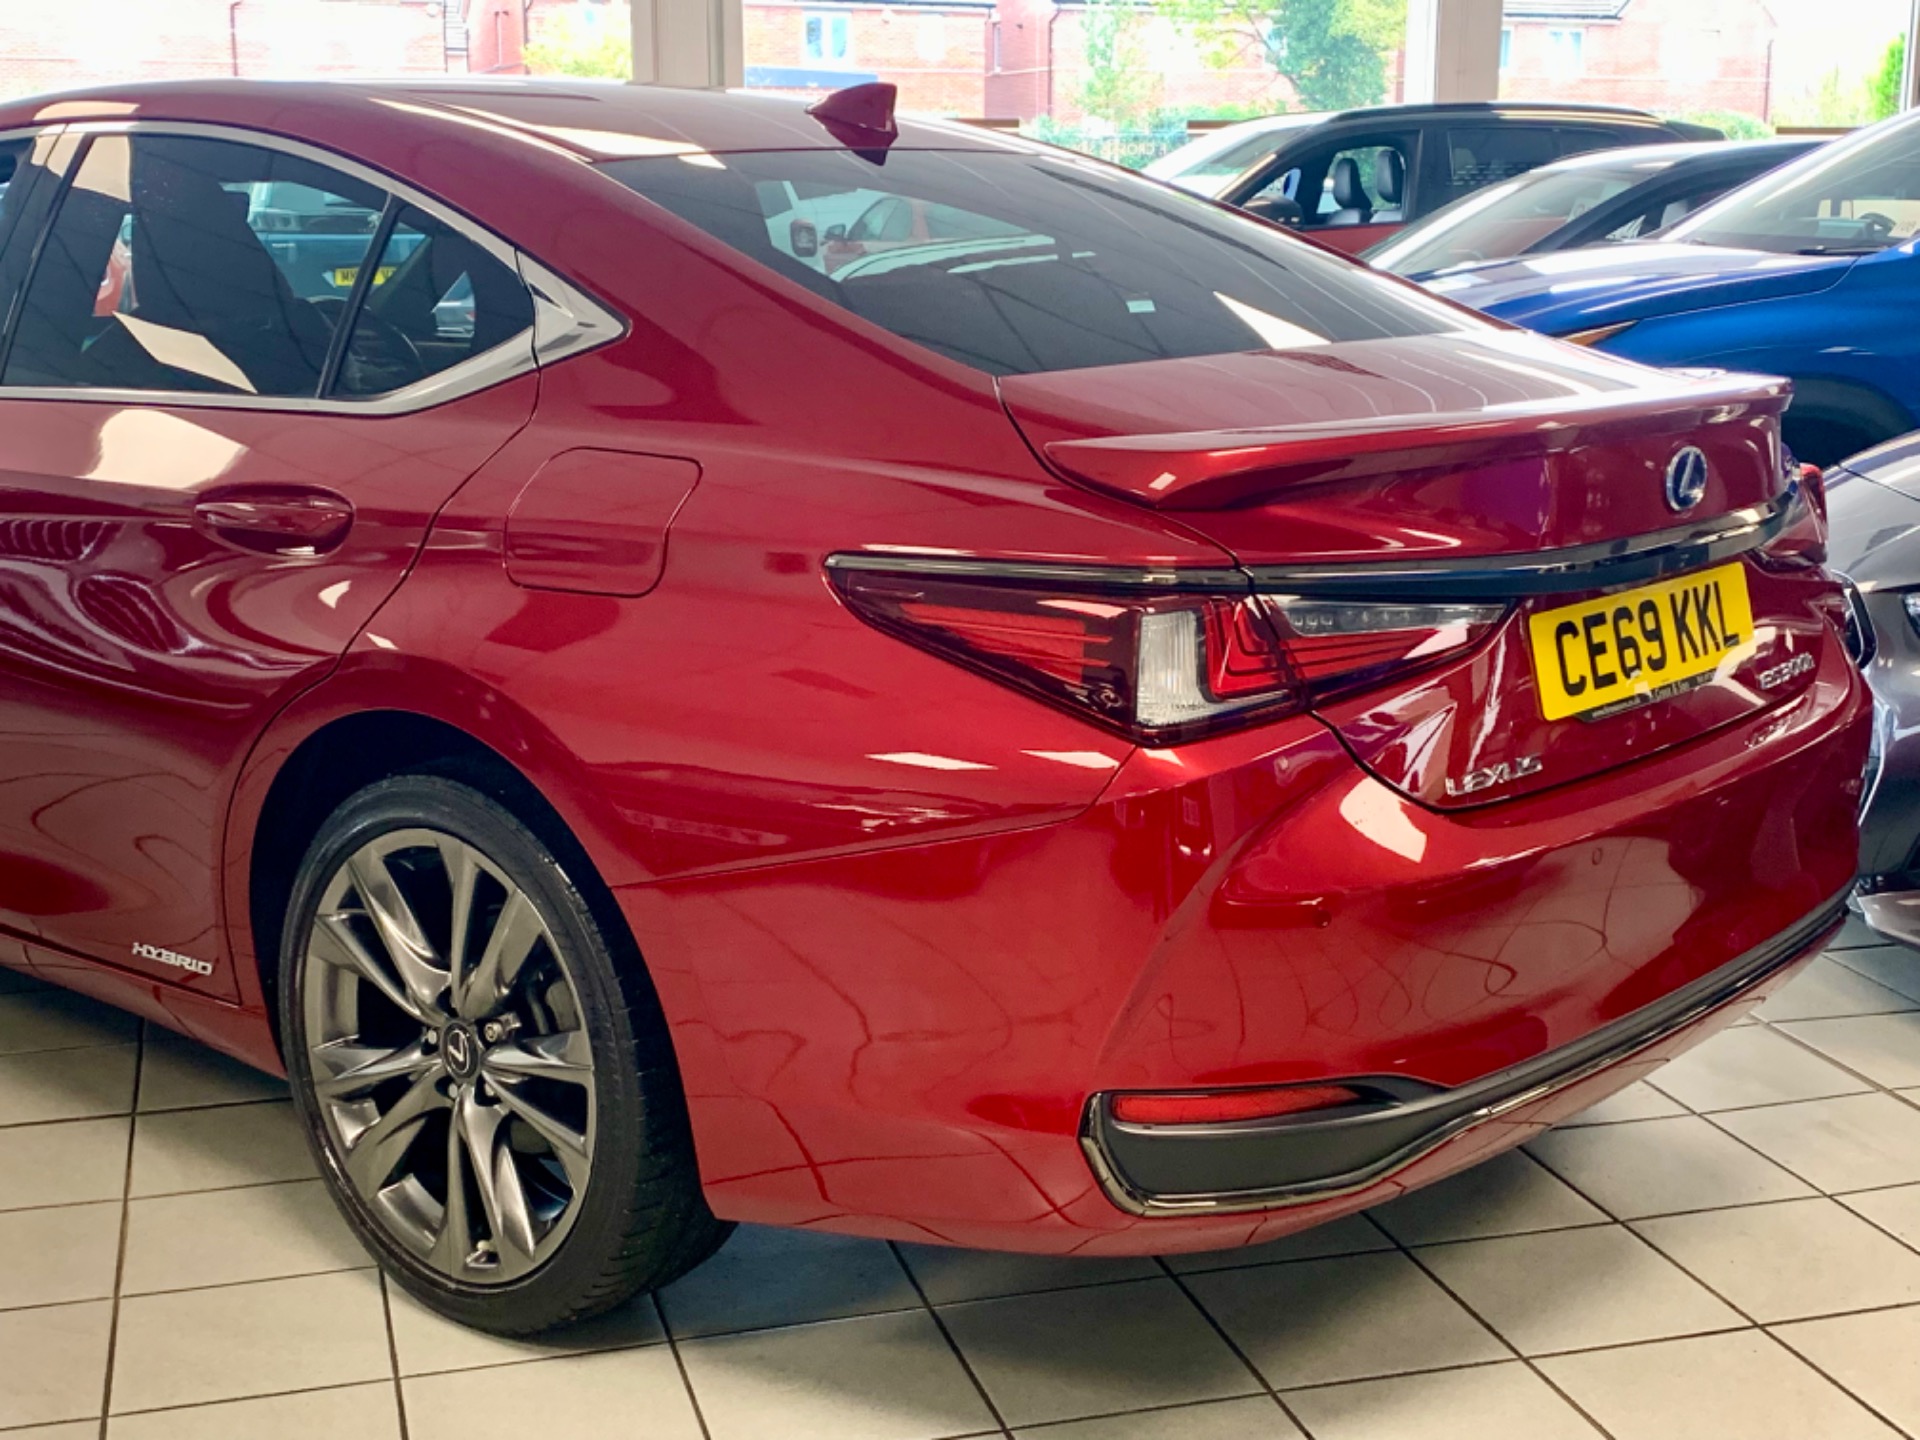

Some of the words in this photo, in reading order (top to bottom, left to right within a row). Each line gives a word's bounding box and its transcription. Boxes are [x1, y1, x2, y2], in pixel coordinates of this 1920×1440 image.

[1554, 599, 1668, 696] CE69
[1669, 580, 1741, 664] KKL
[1444, 756, 1543, 798] LEXUS
[131, 941, 213, 976] HYBRID
